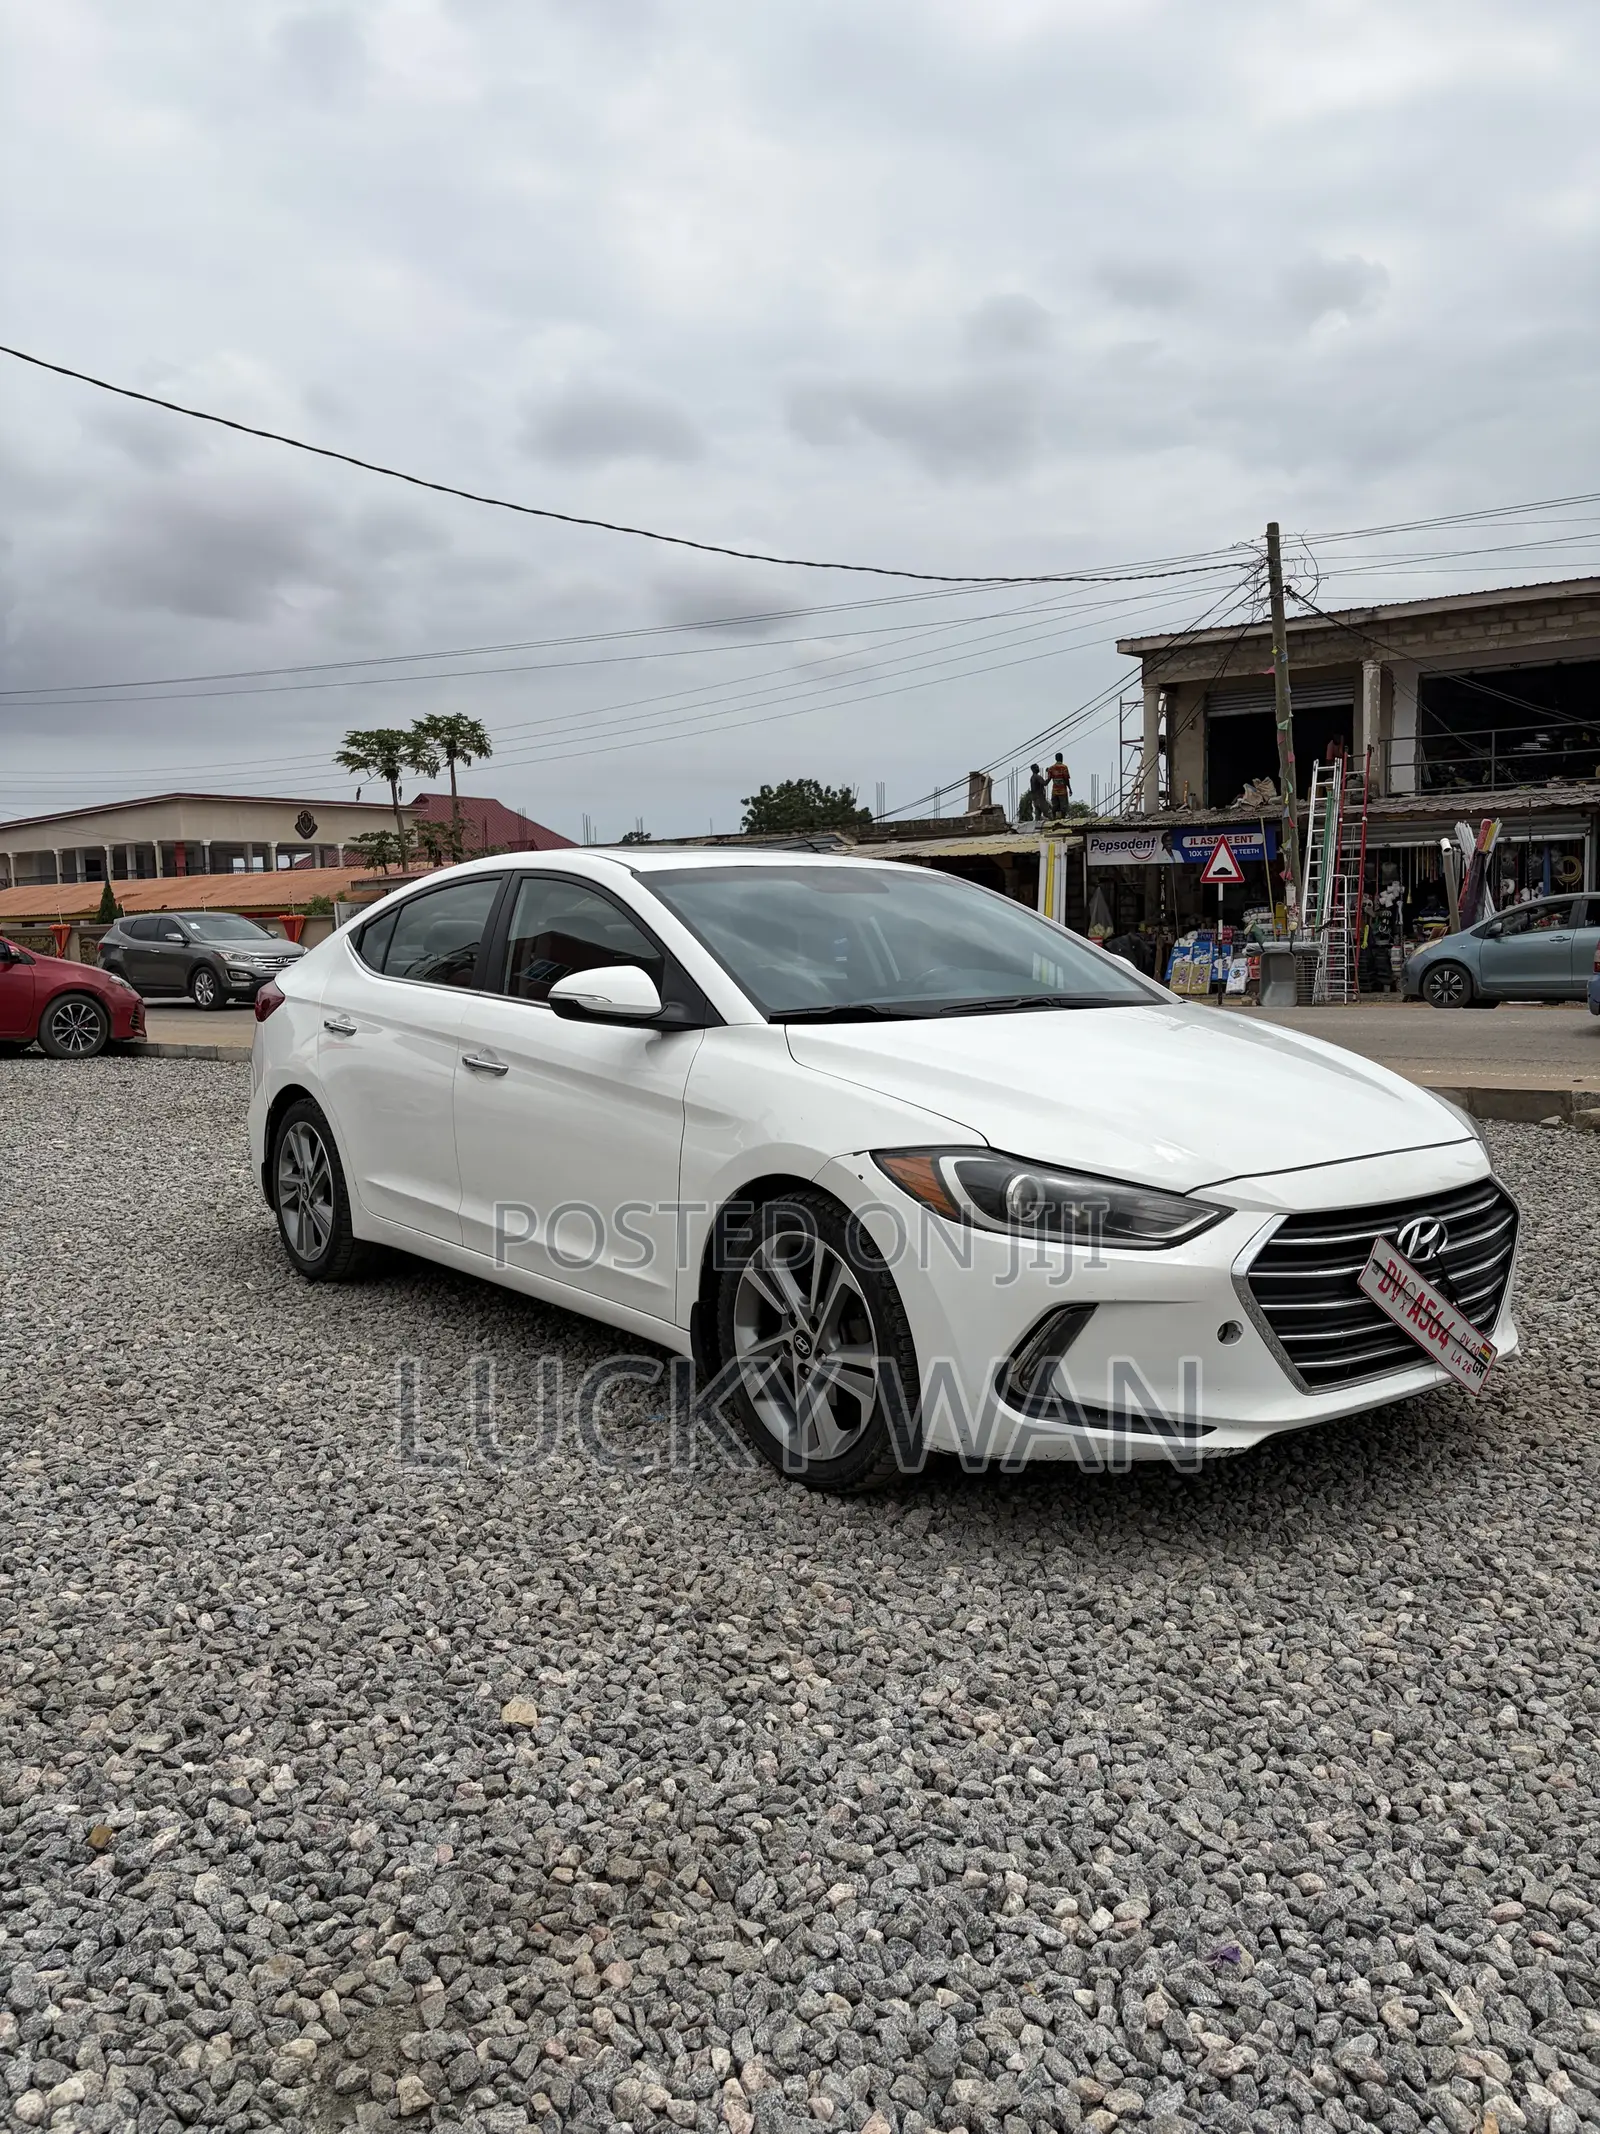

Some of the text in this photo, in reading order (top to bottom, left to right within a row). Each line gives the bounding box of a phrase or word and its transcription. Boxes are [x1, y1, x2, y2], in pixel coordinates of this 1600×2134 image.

[1090, 837, 1156, 853] Pepsodent
[1189, 835, 1254, 846] JL ASAE ENT
[1378, 1259, 1408, 1302] DV
[1406, 1291, 1455, 1349] A564
[1460, 1332, 1471, 1347] DV
[1451, 1350, 1462, 1366] LA
